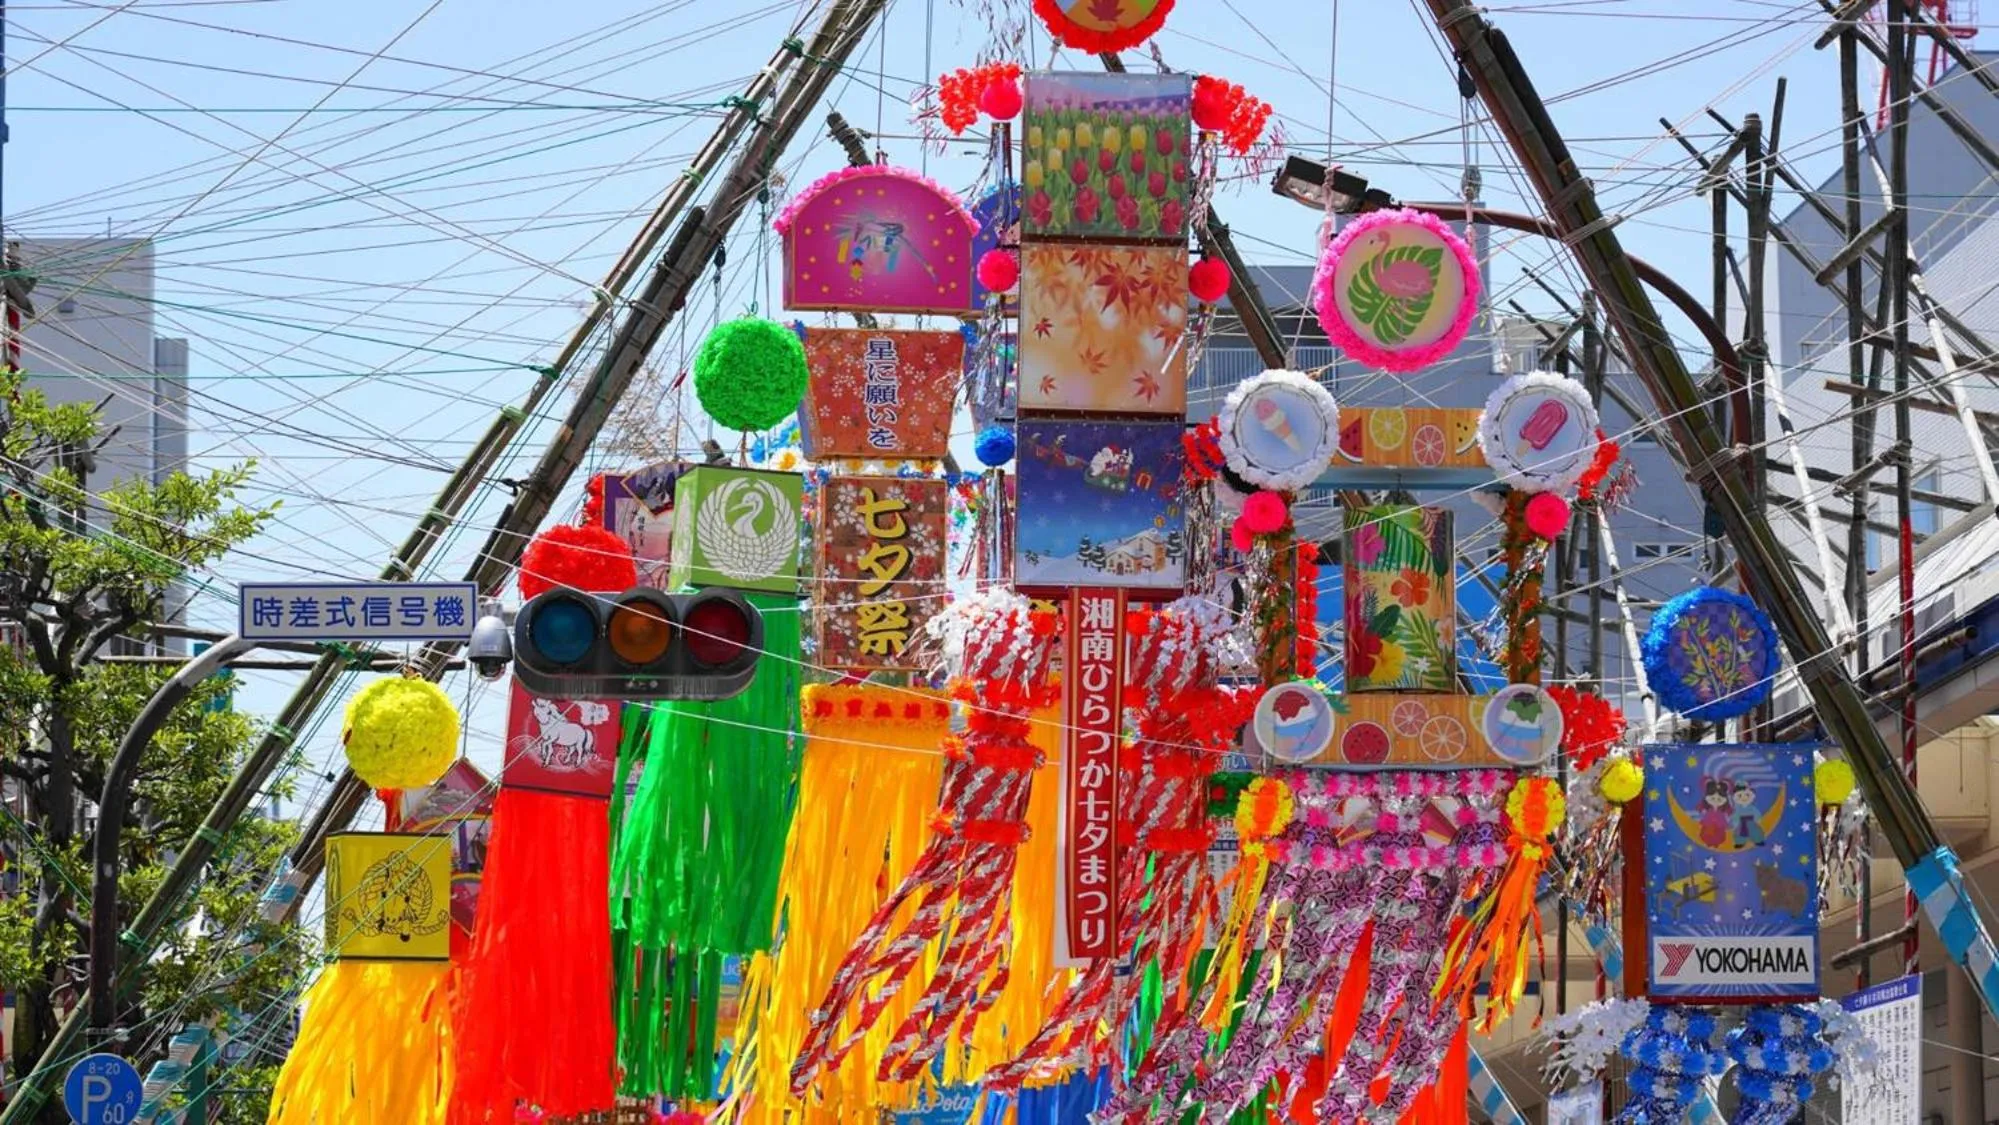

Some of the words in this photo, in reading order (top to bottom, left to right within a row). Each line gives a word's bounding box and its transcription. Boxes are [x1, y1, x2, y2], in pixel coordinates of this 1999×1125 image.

[865, 338, 898, 449] 星に願いを
[856, 487, 909, 656] 七夕祭
[253, 596, 465, 628] 時差式信号機
[1077, 597, 1115, 949] 湘南ひらつか七夕まつり
[1696, 947, 1809, 974] YOKOHAMA
[88, 1062, 121, 1075] 8-20
[82, 1075, 112, 1125] P
[102, 1102, 125, 1124] 60
